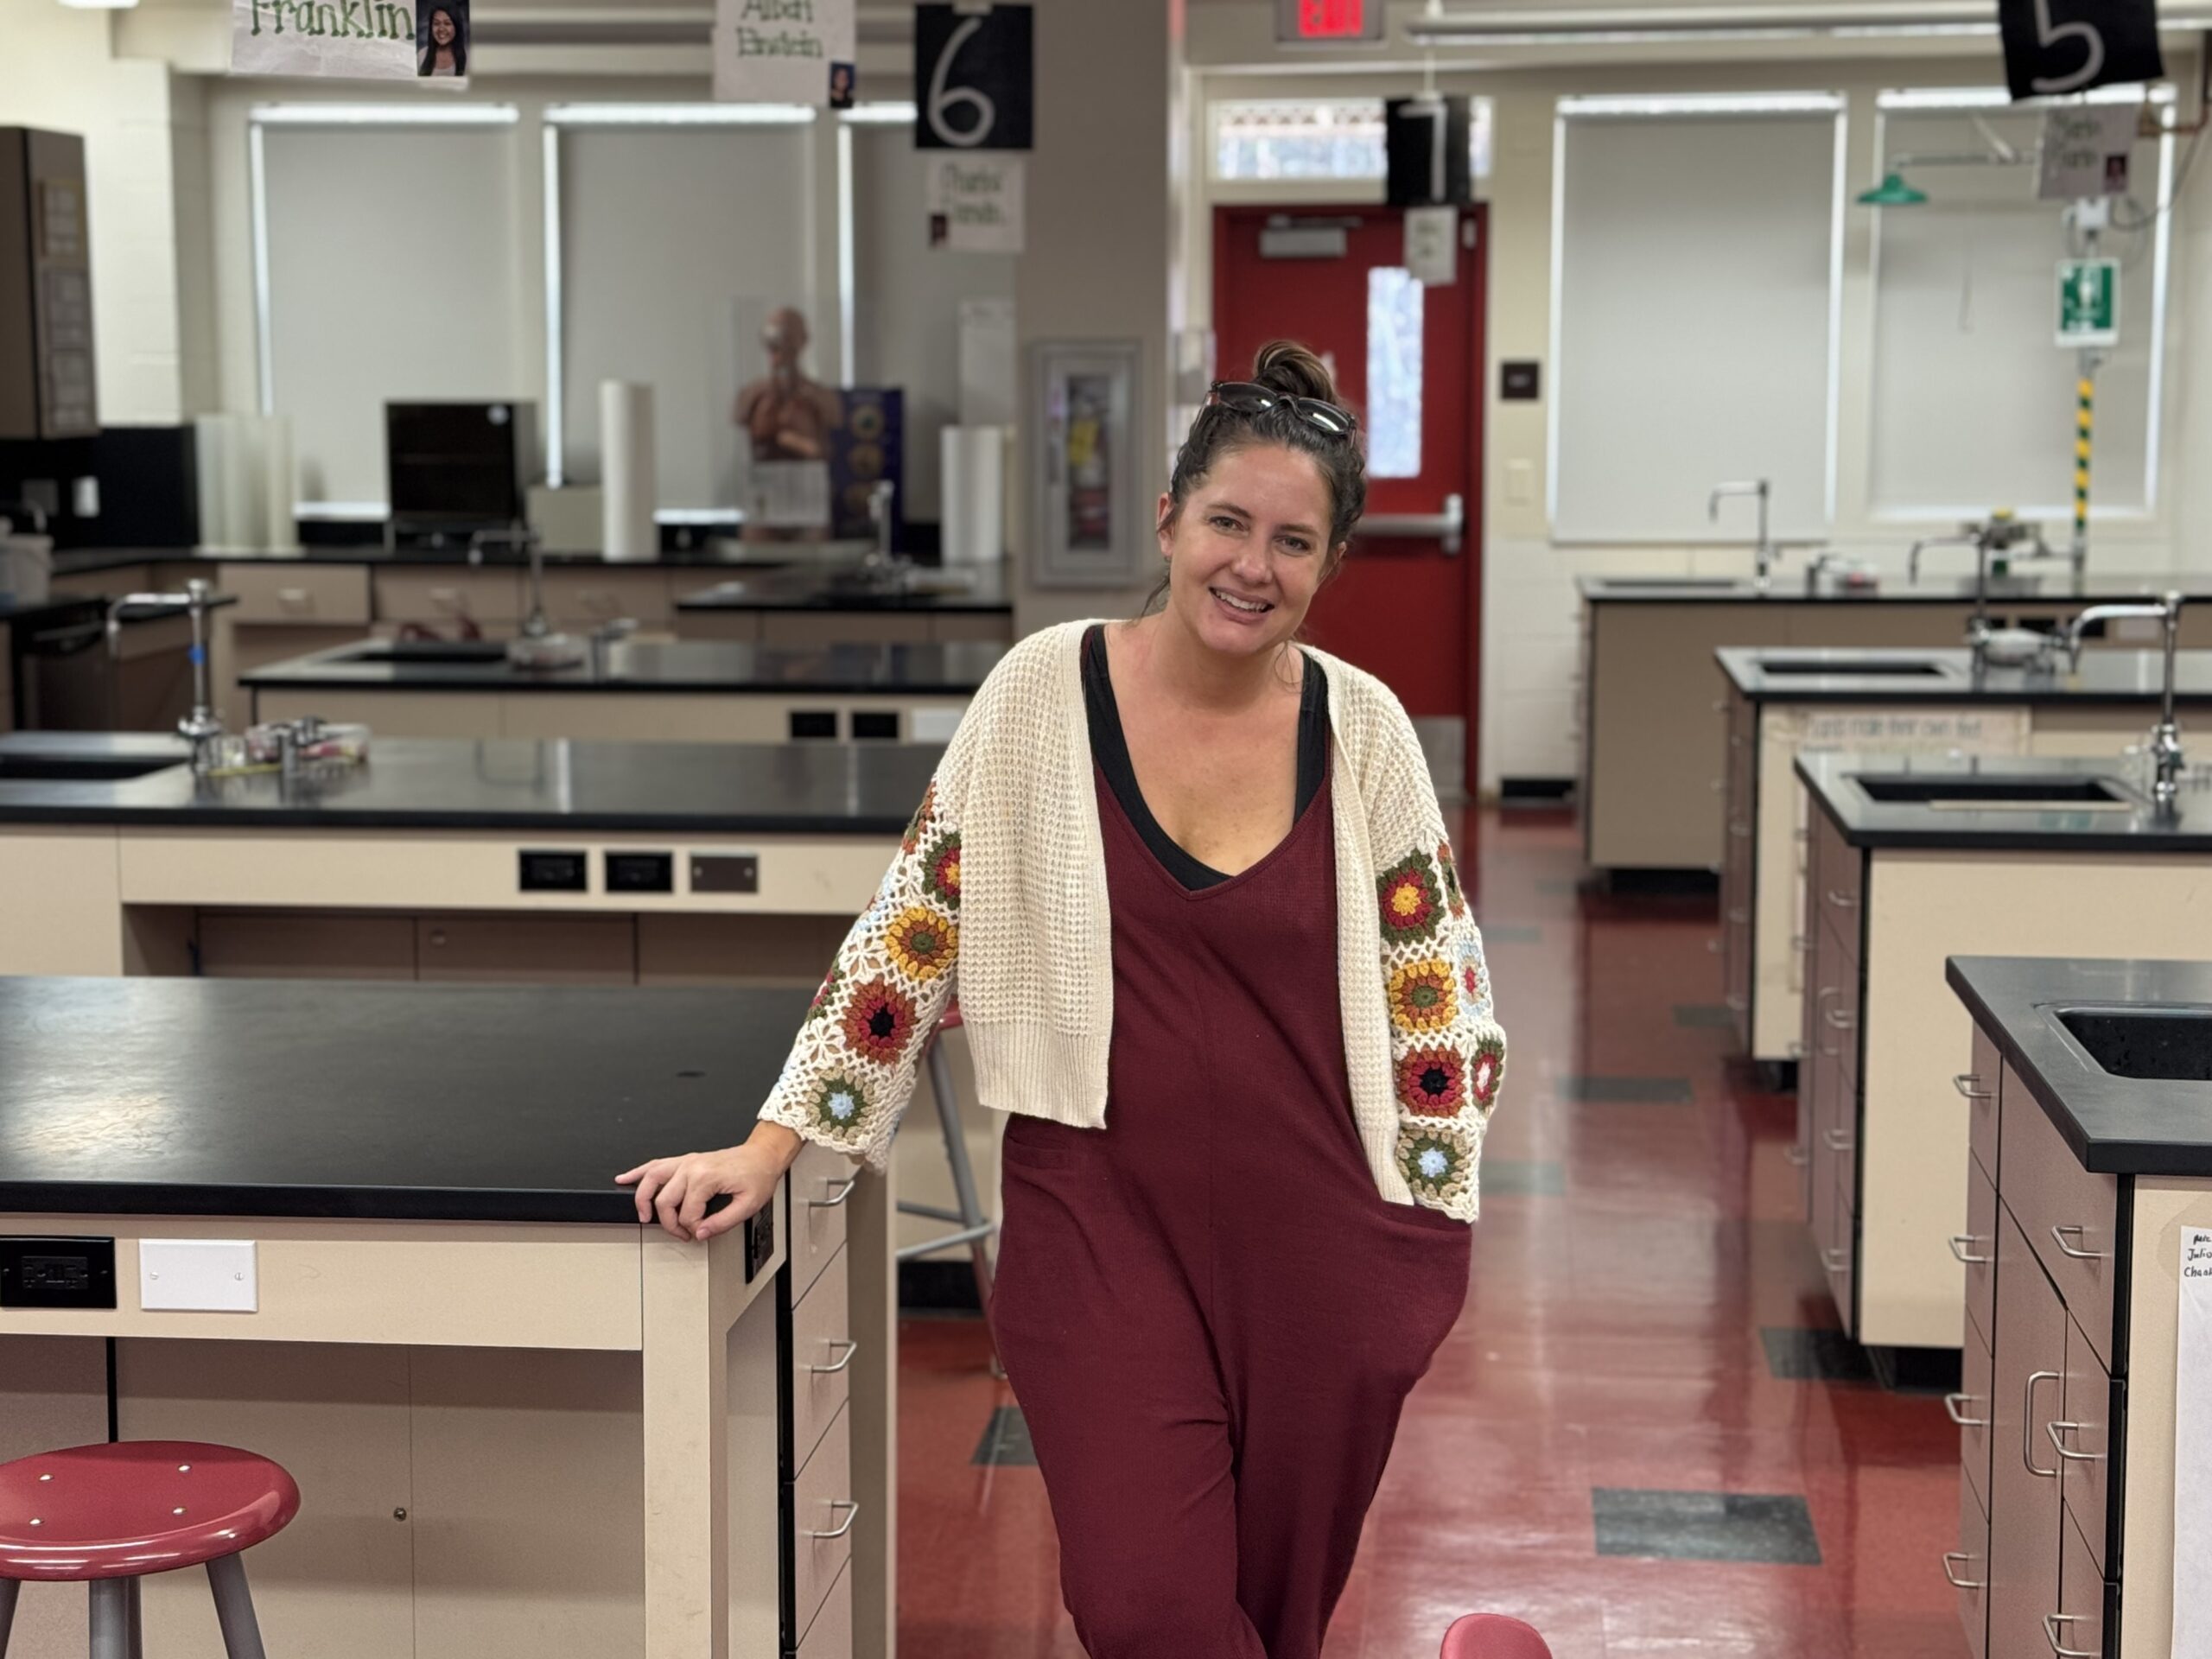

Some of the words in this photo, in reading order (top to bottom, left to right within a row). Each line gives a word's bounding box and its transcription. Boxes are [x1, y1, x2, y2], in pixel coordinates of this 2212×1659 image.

[251, 0, 416, 40] Franklin
[2032, 0, 2106, 93] 5
[927, 16, 995, 146] 6
